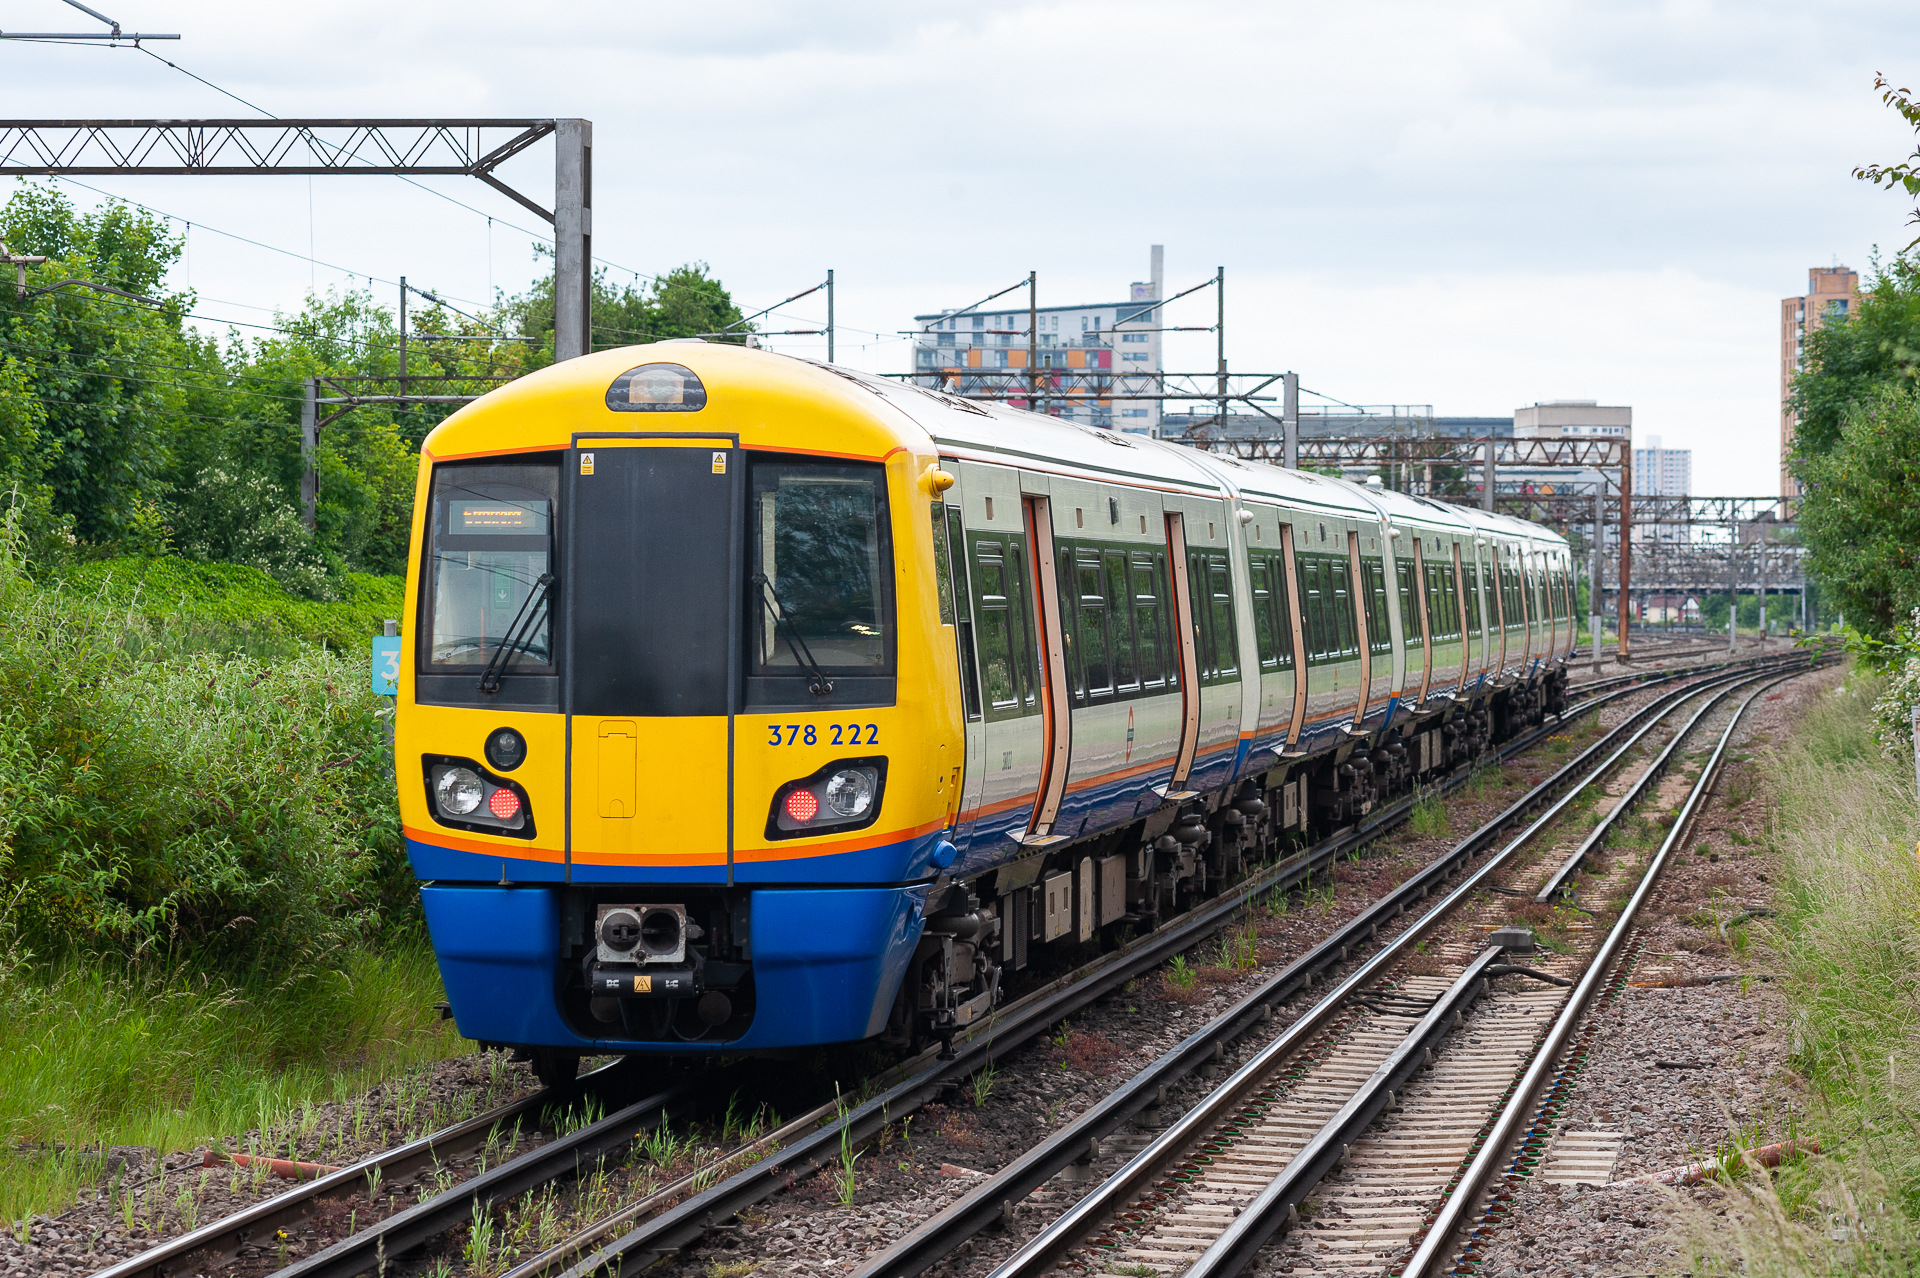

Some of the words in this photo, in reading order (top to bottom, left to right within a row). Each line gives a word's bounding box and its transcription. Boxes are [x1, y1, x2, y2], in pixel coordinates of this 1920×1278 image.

[380, 650, 400, 680] 3
[768, 724, 817, 746] 378
[829, 723, 879, 745] 222
